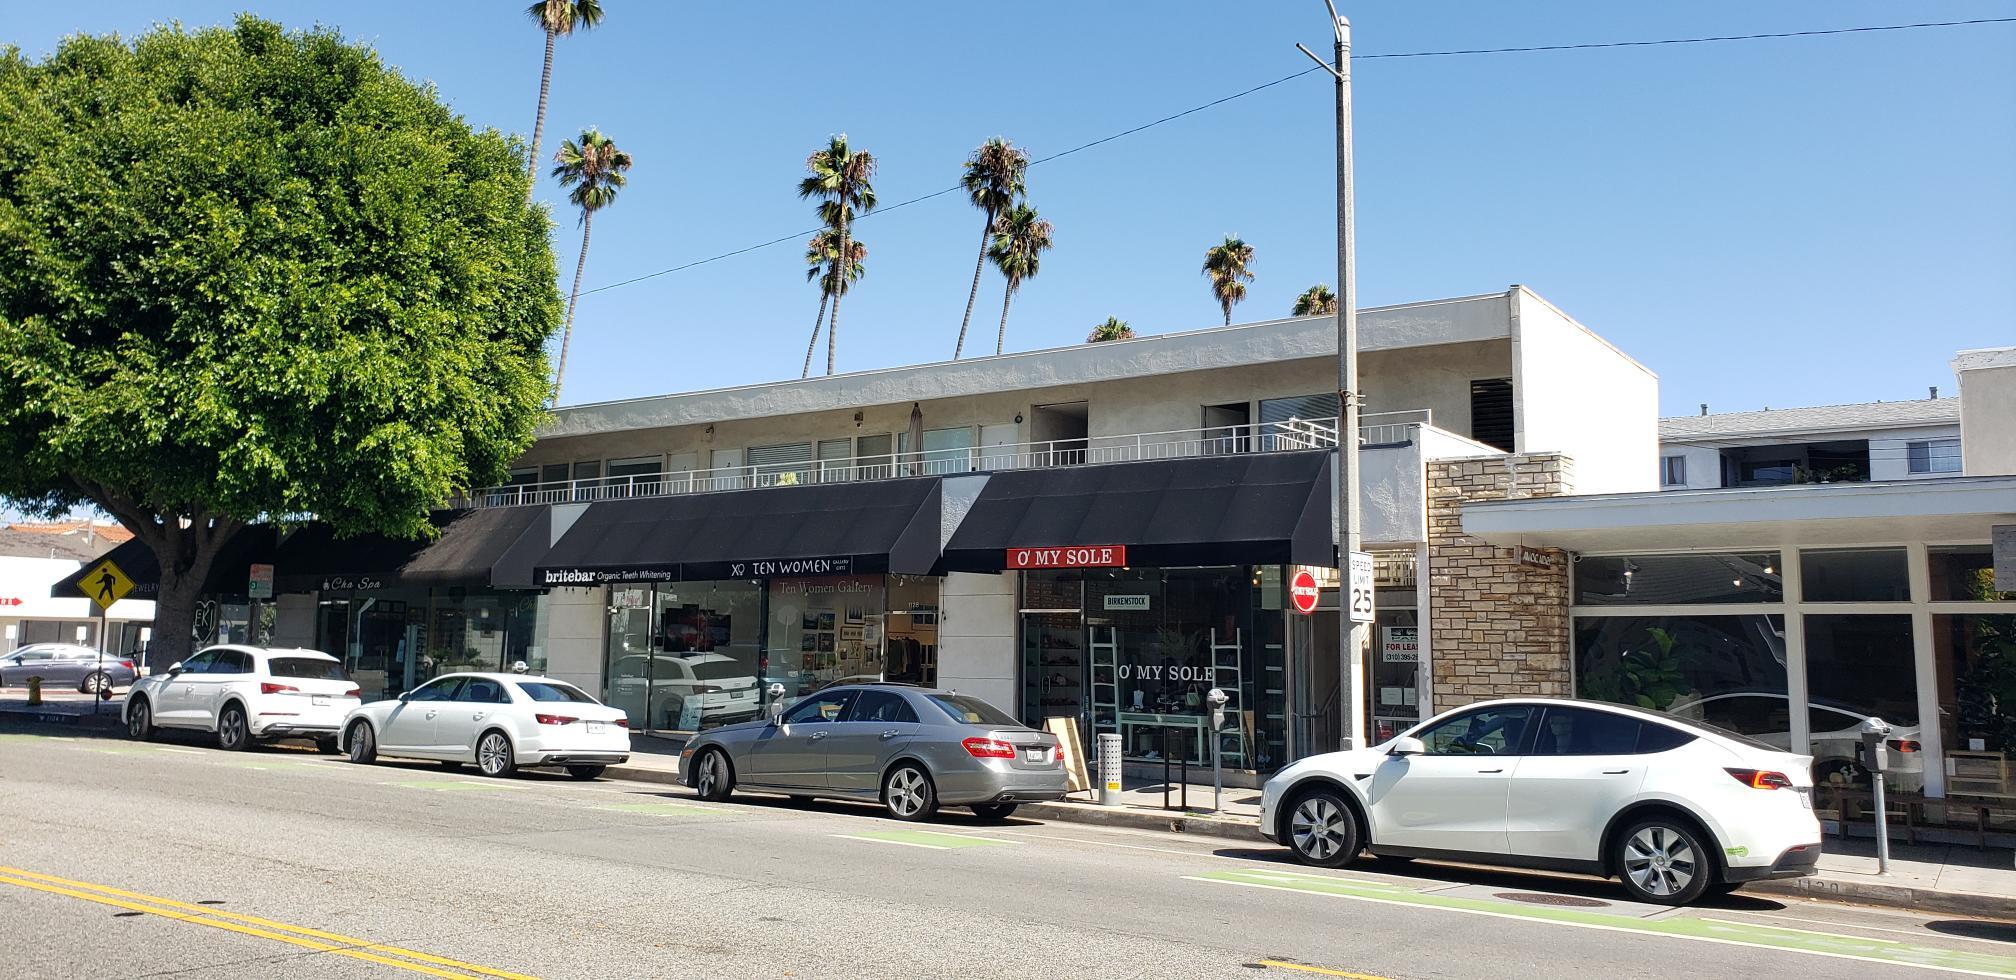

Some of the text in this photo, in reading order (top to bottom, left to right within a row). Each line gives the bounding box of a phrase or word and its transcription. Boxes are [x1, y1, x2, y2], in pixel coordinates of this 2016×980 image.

[1017, 548, 1112, 566] O' MY SOLE
[752, 561, 775, 575] TEN
[779, 559, 830, 574] WOMEN
[1352, 560, 1371, 572] SPEED
[545, 569, 671, 583] britebar Organic Teeth Whitening
[1354, 574, 1369, 585] LIMIT
[132, 583, 160, 594] JEWELRY
[331, 577, 381, 590] Cha Spa
[780, 580, 873, 594] Ten Women Gallery
[1107, 597, 1146, 606] BIRKENSTOCK
[1353, 588, 1372, 613] 25
[1385, 643, 1401, 651] FOR
[1386, 653, 1400, 661] (310)
[1118, 664, 1214, 681] O' MY SOLE
